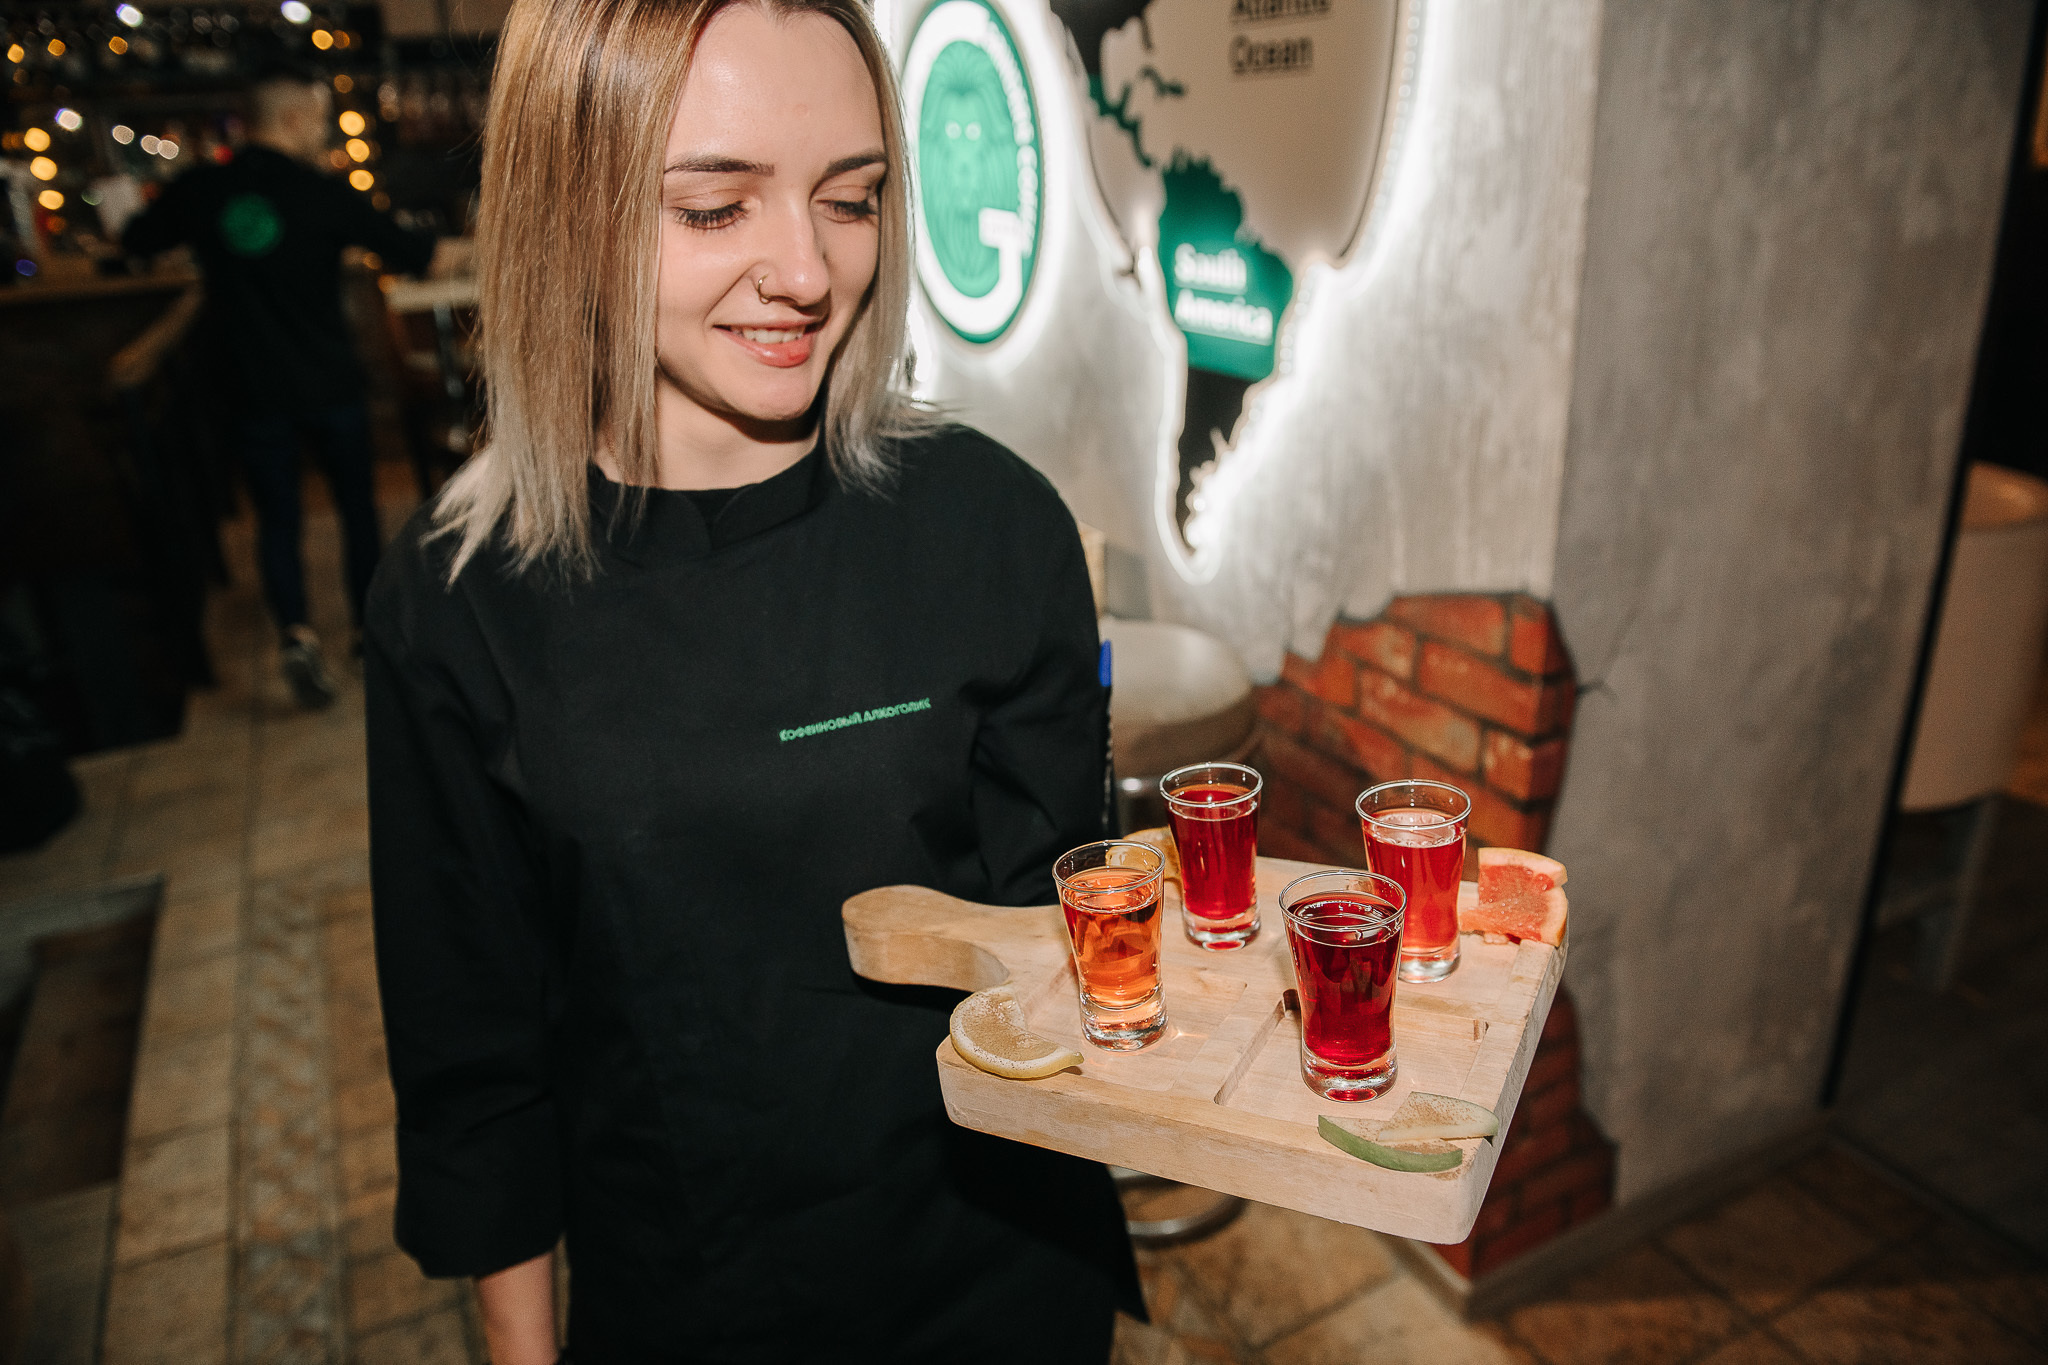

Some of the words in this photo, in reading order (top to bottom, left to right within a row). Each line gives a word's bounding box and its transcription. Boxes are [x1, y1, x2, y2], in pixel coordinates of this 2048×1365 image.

[1230, 35, 1312, 71] Ocean
[1175, 242, 1246, 290] South
[1175, 288, 1273, 338] America
